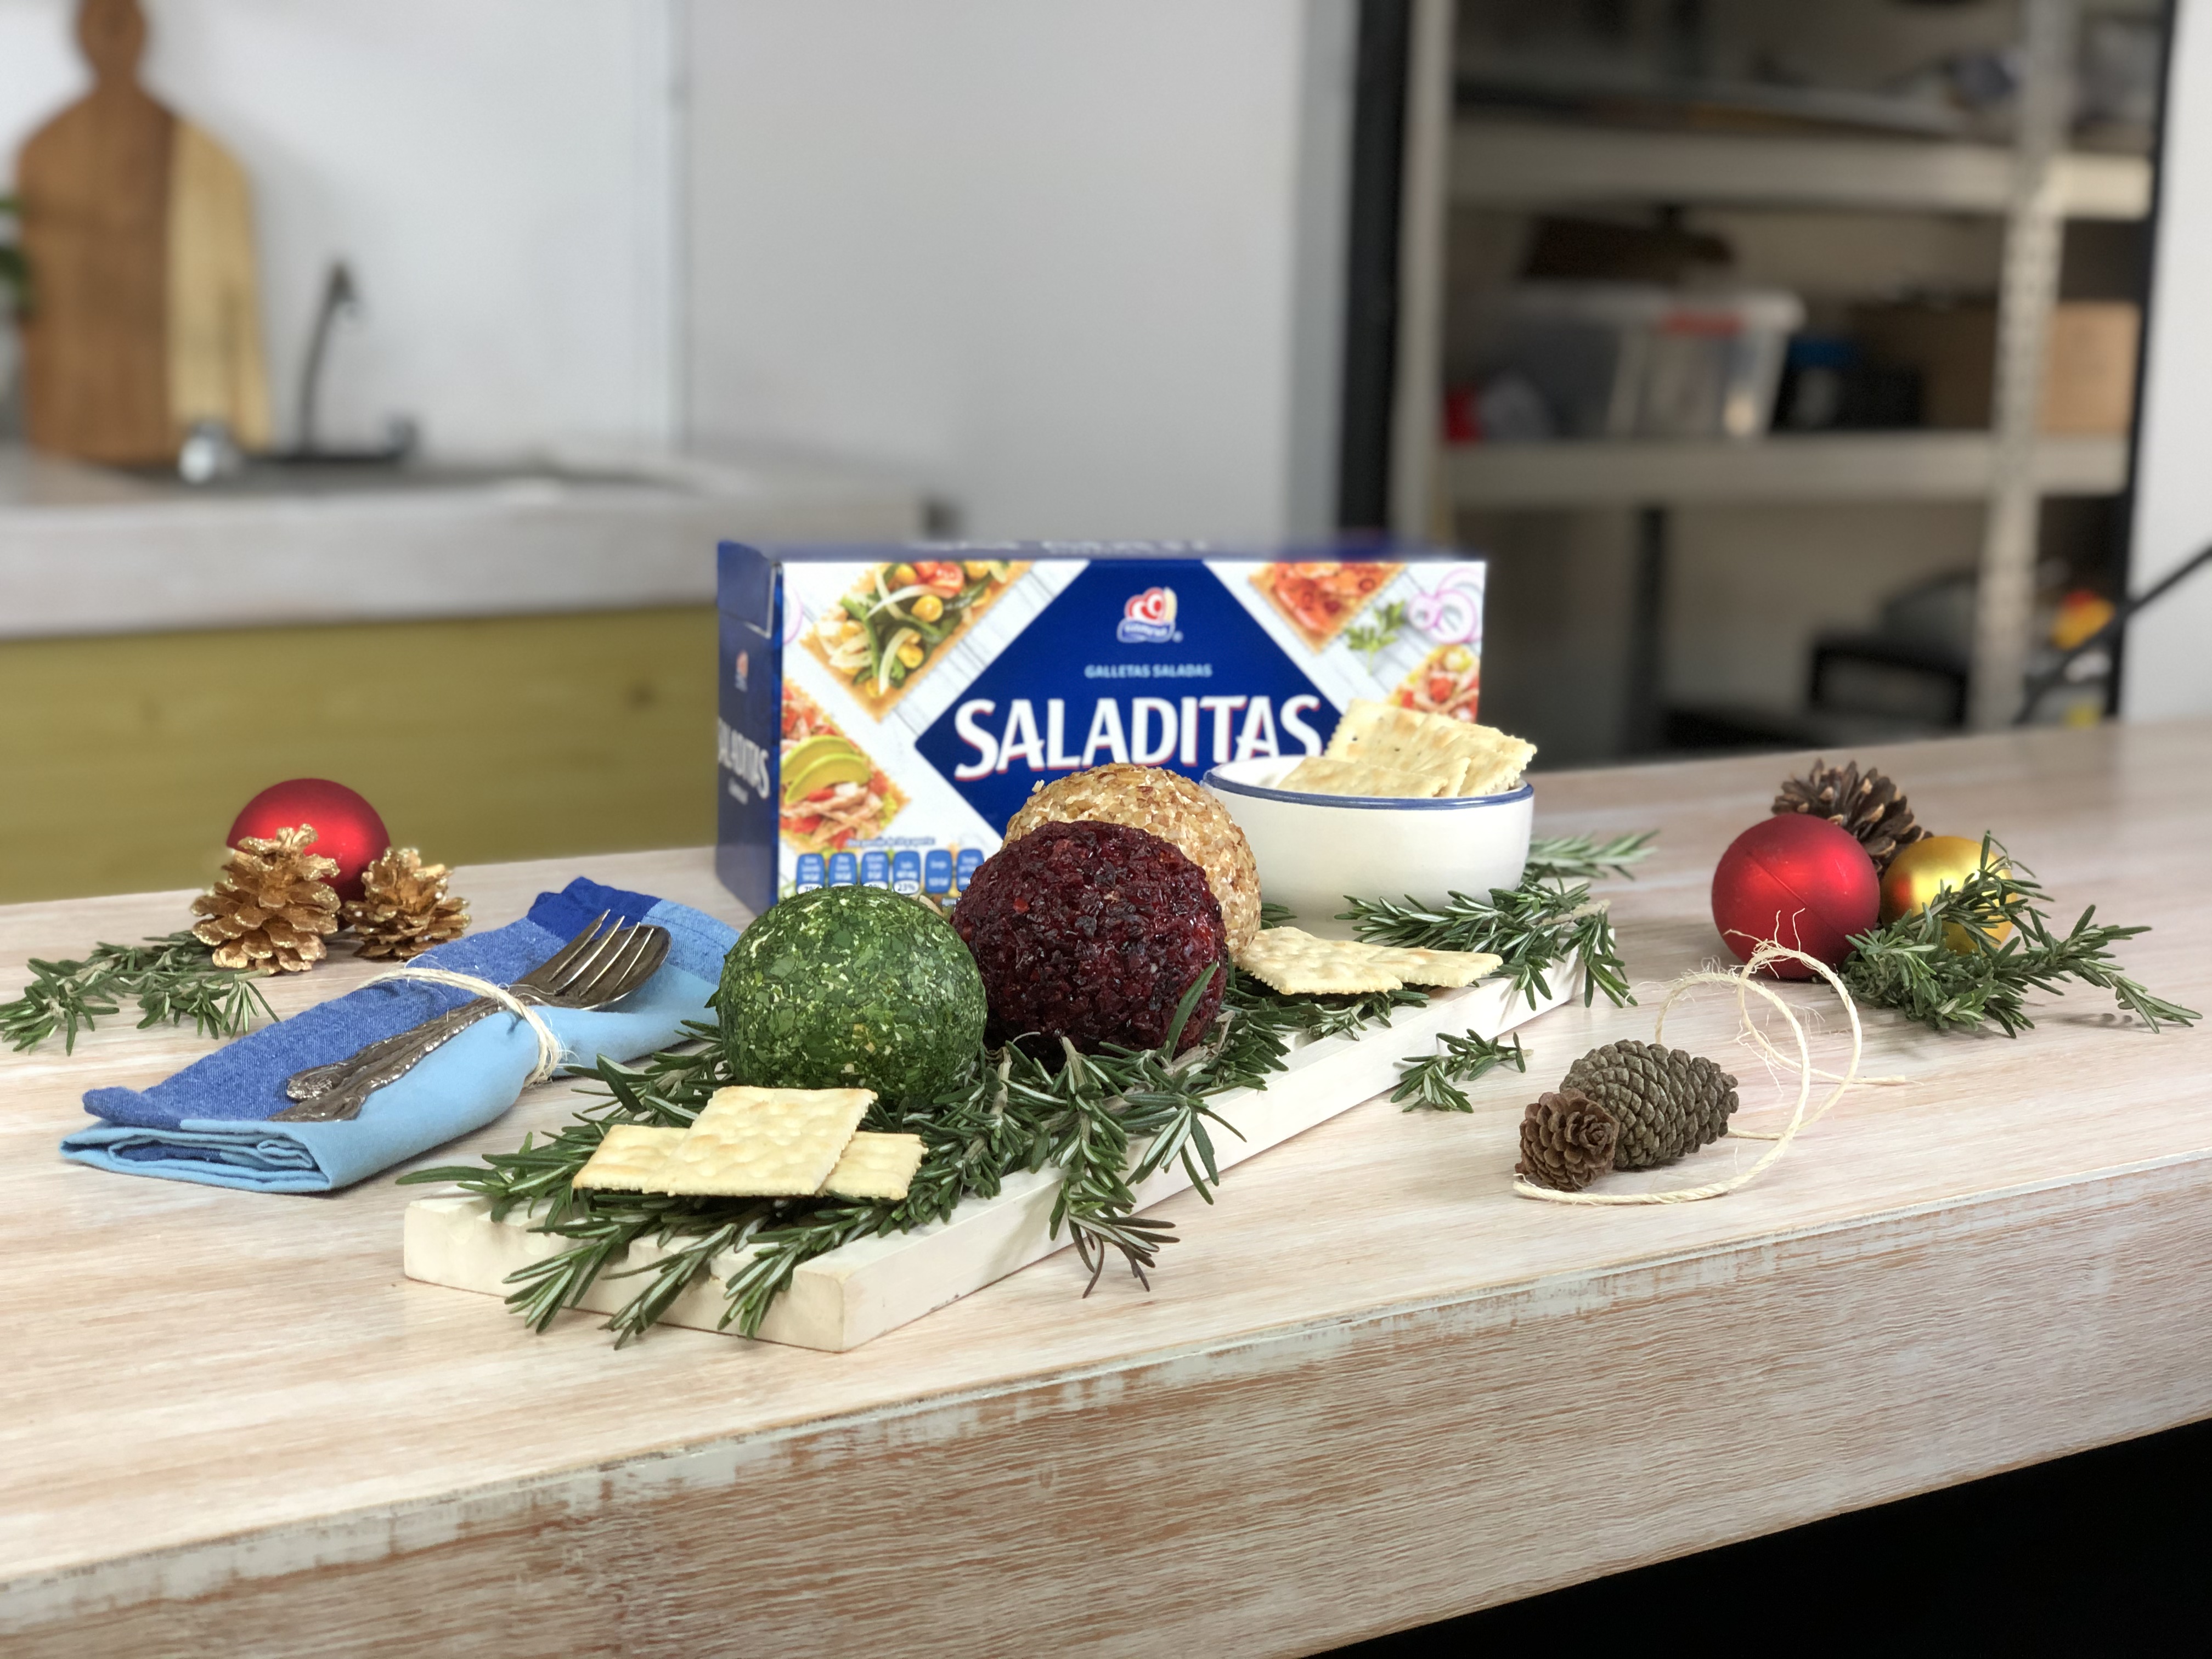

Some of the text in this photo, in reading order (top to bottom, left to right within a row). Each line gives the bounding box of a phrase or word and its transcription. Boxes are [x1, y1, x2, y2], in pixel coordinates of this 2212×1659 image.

[1084, 663, 1213, 678] GALLETAS SALADAS
[954, 695, 1323, 781] SALADITAS
[898, 883, 916, 892] 23%
